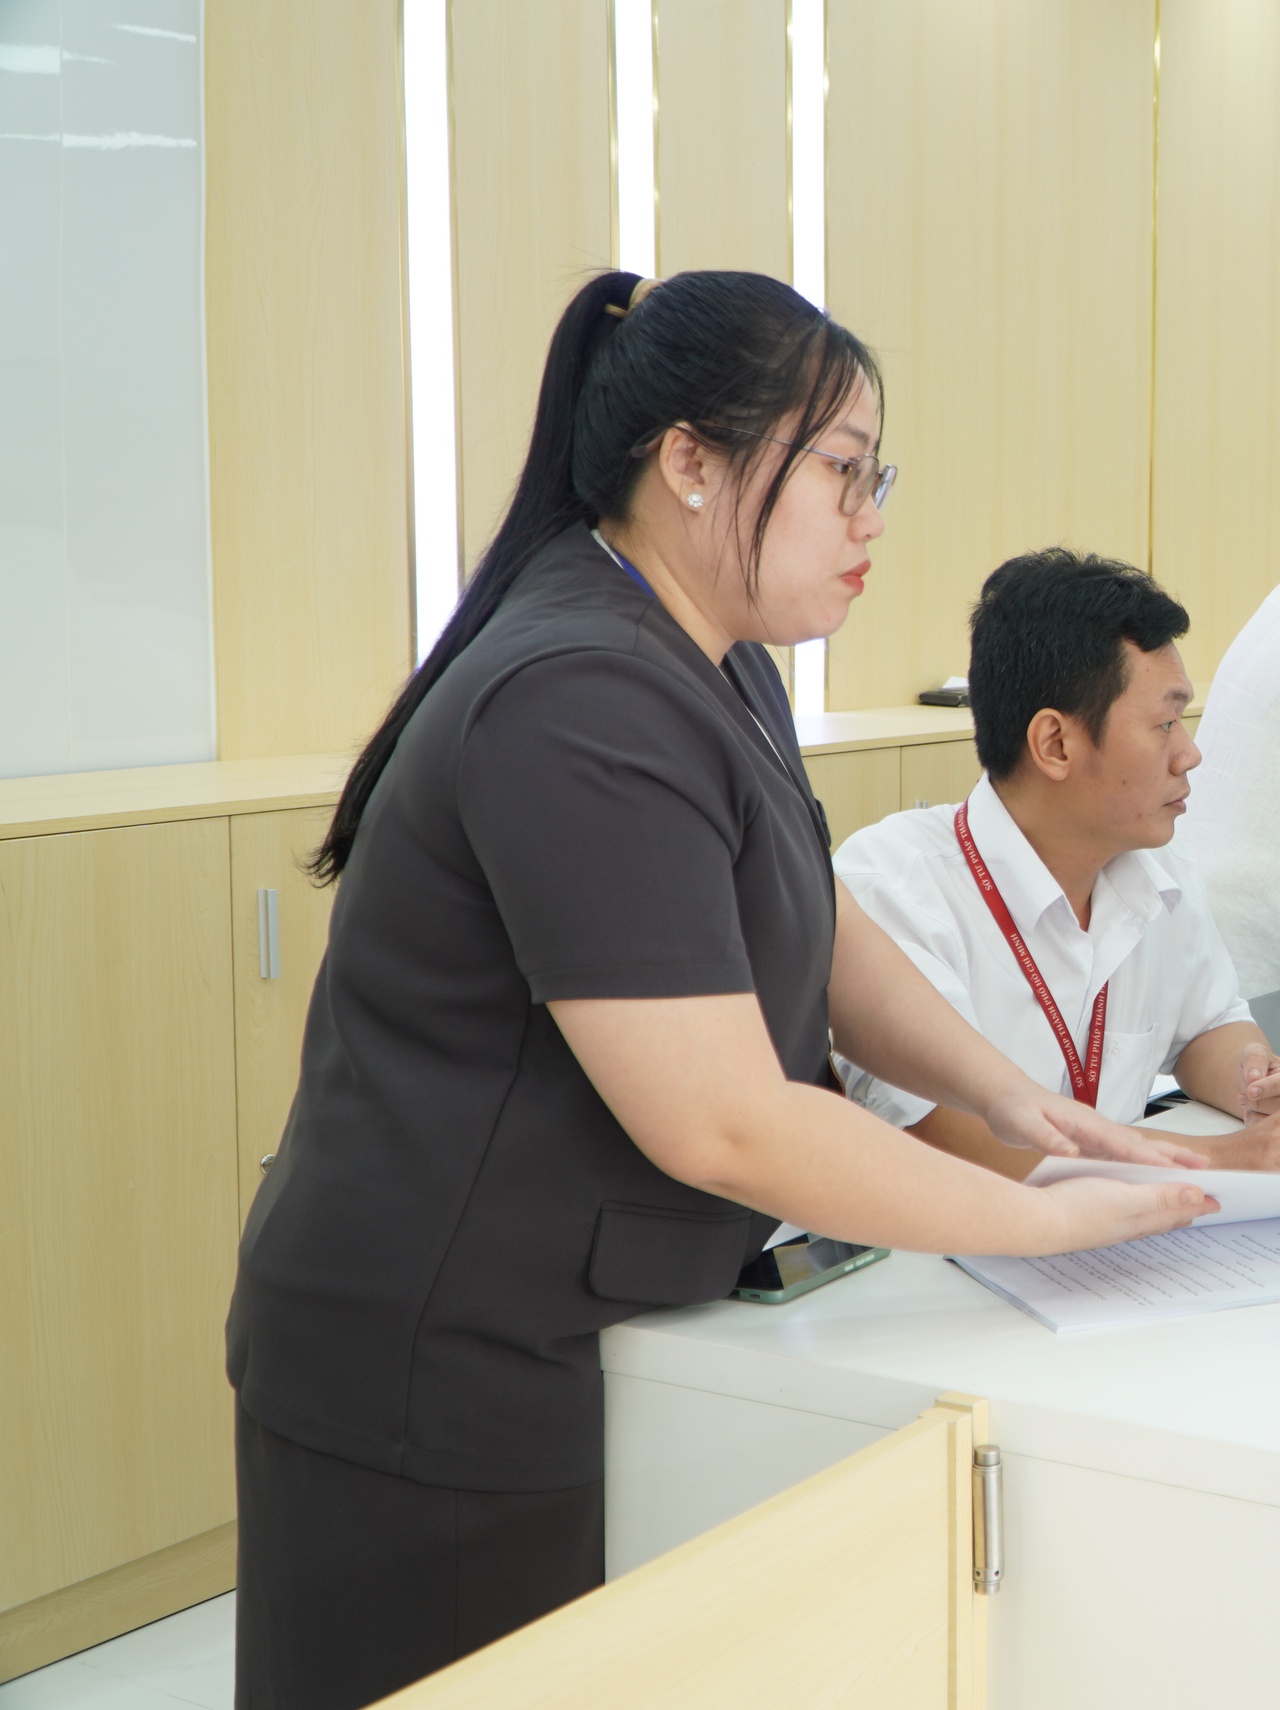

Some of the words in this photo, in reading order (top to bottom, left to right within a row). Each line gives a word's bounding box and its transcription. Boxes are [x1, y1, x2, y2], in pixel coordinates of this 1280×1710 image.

[964, 840, 979, 864] PHÁP
[974, 865, 986, 879] TƯ
[981, 879, 993, 891] SỞ
[1010, 933, 1027, 957] MINH
[1048, 1006, 1066, 1038] THÀNH
[1062, 1038, 1076, 1061] PHÁP
[1092, 1029, 1101, 1053] PHÁP
[1090, 1054, 1099, 1068] TƯ
[1088, 1070, 1097, 1083] SỞ
